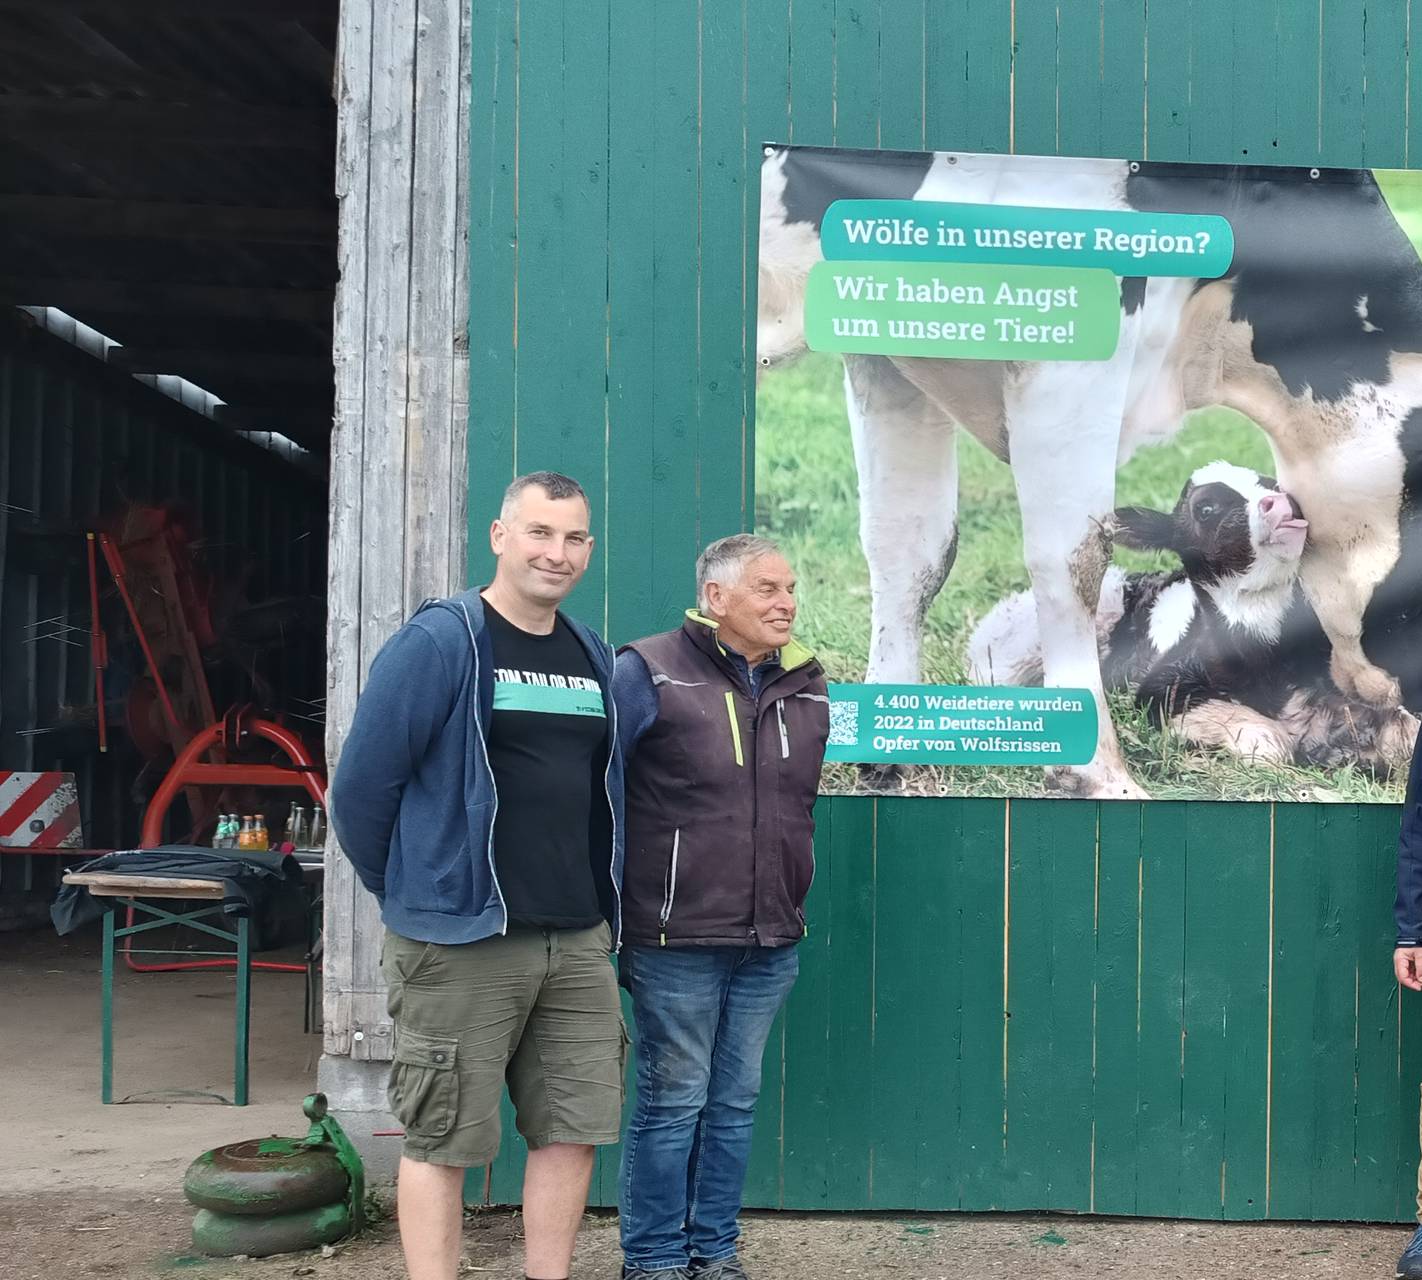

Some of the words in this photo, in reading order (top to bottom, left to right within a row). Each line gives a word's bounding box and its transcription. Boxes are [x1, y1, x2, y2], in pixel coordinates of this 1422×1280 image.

[843, 218, 929, 246] Wölfe
[937, 220, 966, 247] in
[974, 227, 1086, 250] unserer
[1094, 228, 1211, 258] Region?
[833, 275, 888, 301] Wir
[896, 277, 985, 305] haben
[993, 282, 1078, 313] Angst
[832, 317, 880, 337] um
[888, 319, 985, 341] unsere
[994, 317, 1074, 344] Tiere!
[874, 694, 919, 710] 4.400
[924, 694, 1014, 712] Weidetiere
[1019, 697, 1083, 712] wurden
[873, 715, 914, 730] 2022
[917, 715, 935, 731] in
[939, 716, 1044, 732] Deutschland
[873, 735, 920, 754] Opfer
[924, 740, 956, 752] von
[961, 737, 1062, 753] Wolfsrissen
